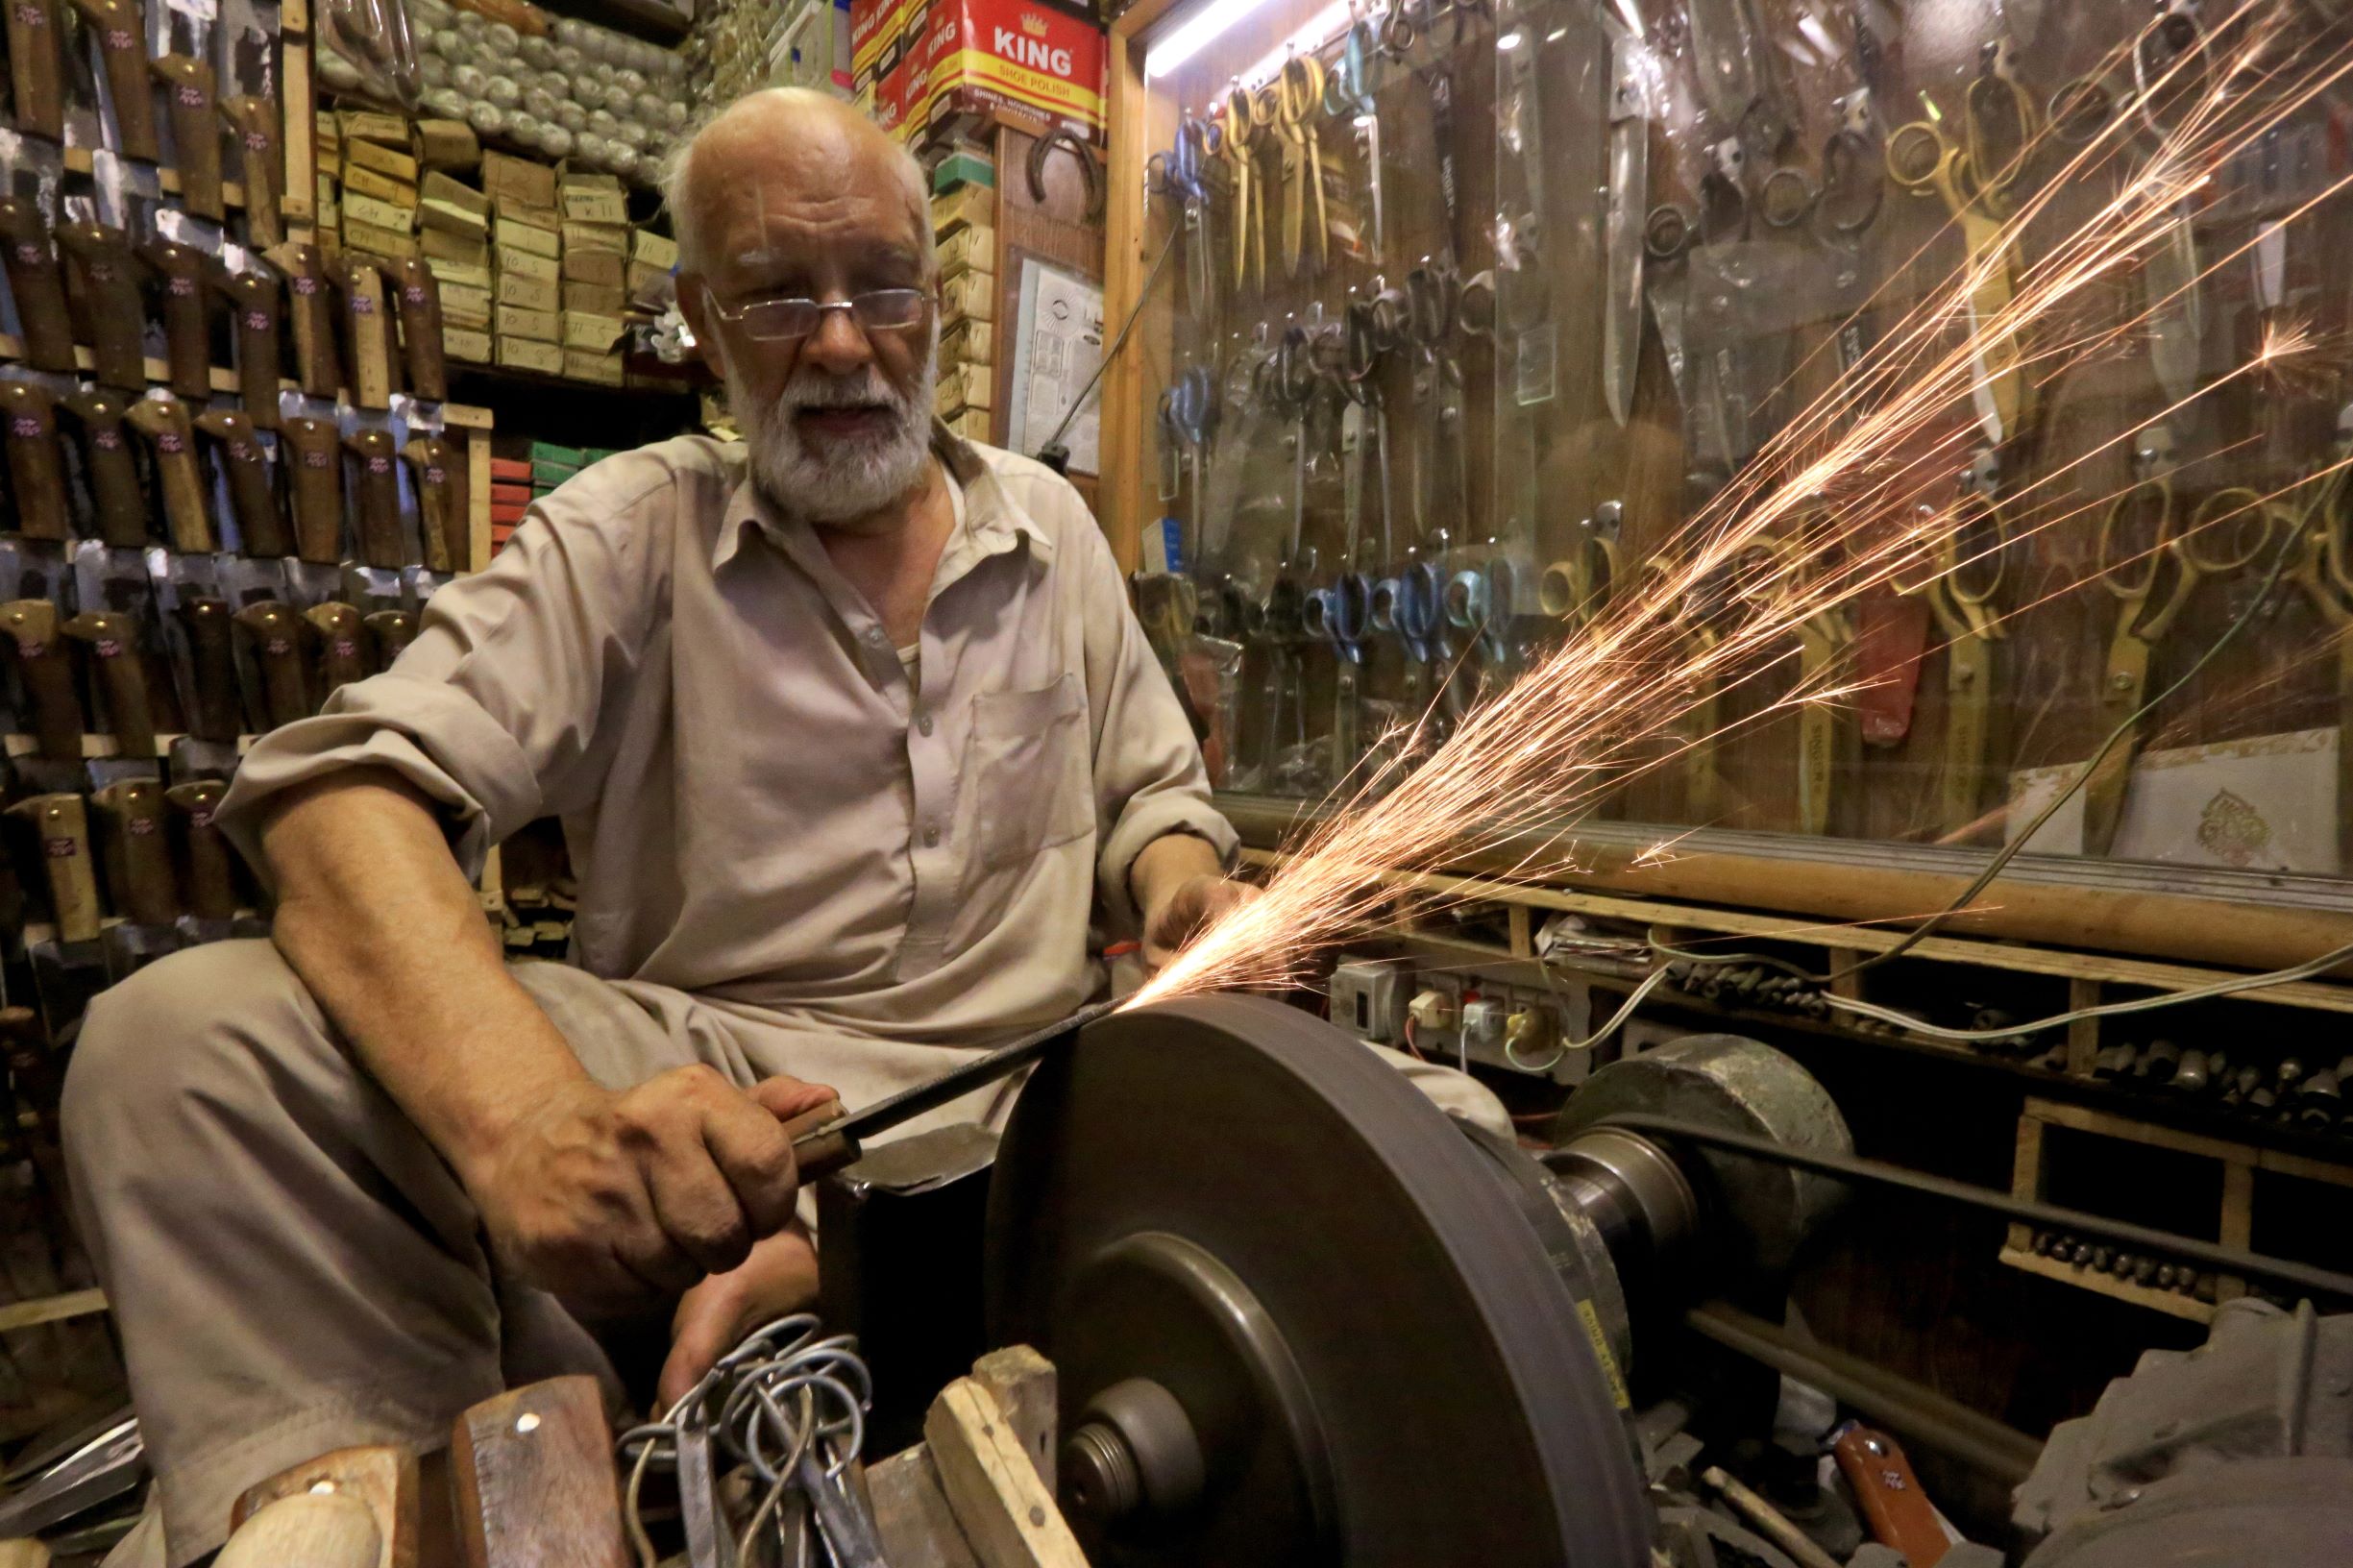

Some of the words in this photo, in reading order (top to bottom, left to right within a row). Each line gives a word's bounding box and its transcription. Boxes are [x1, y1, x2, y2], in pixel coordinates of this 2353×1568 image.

[927, 20, 956, 61] KING
[994, 25, 1072, 77] KING
[906, 68, 928, 102] KING
[999, 63, 1027, 85] SHOE
[1030, 77, 1071, 98] POLISH
[1808, 723, 1824, 783] SINGER
